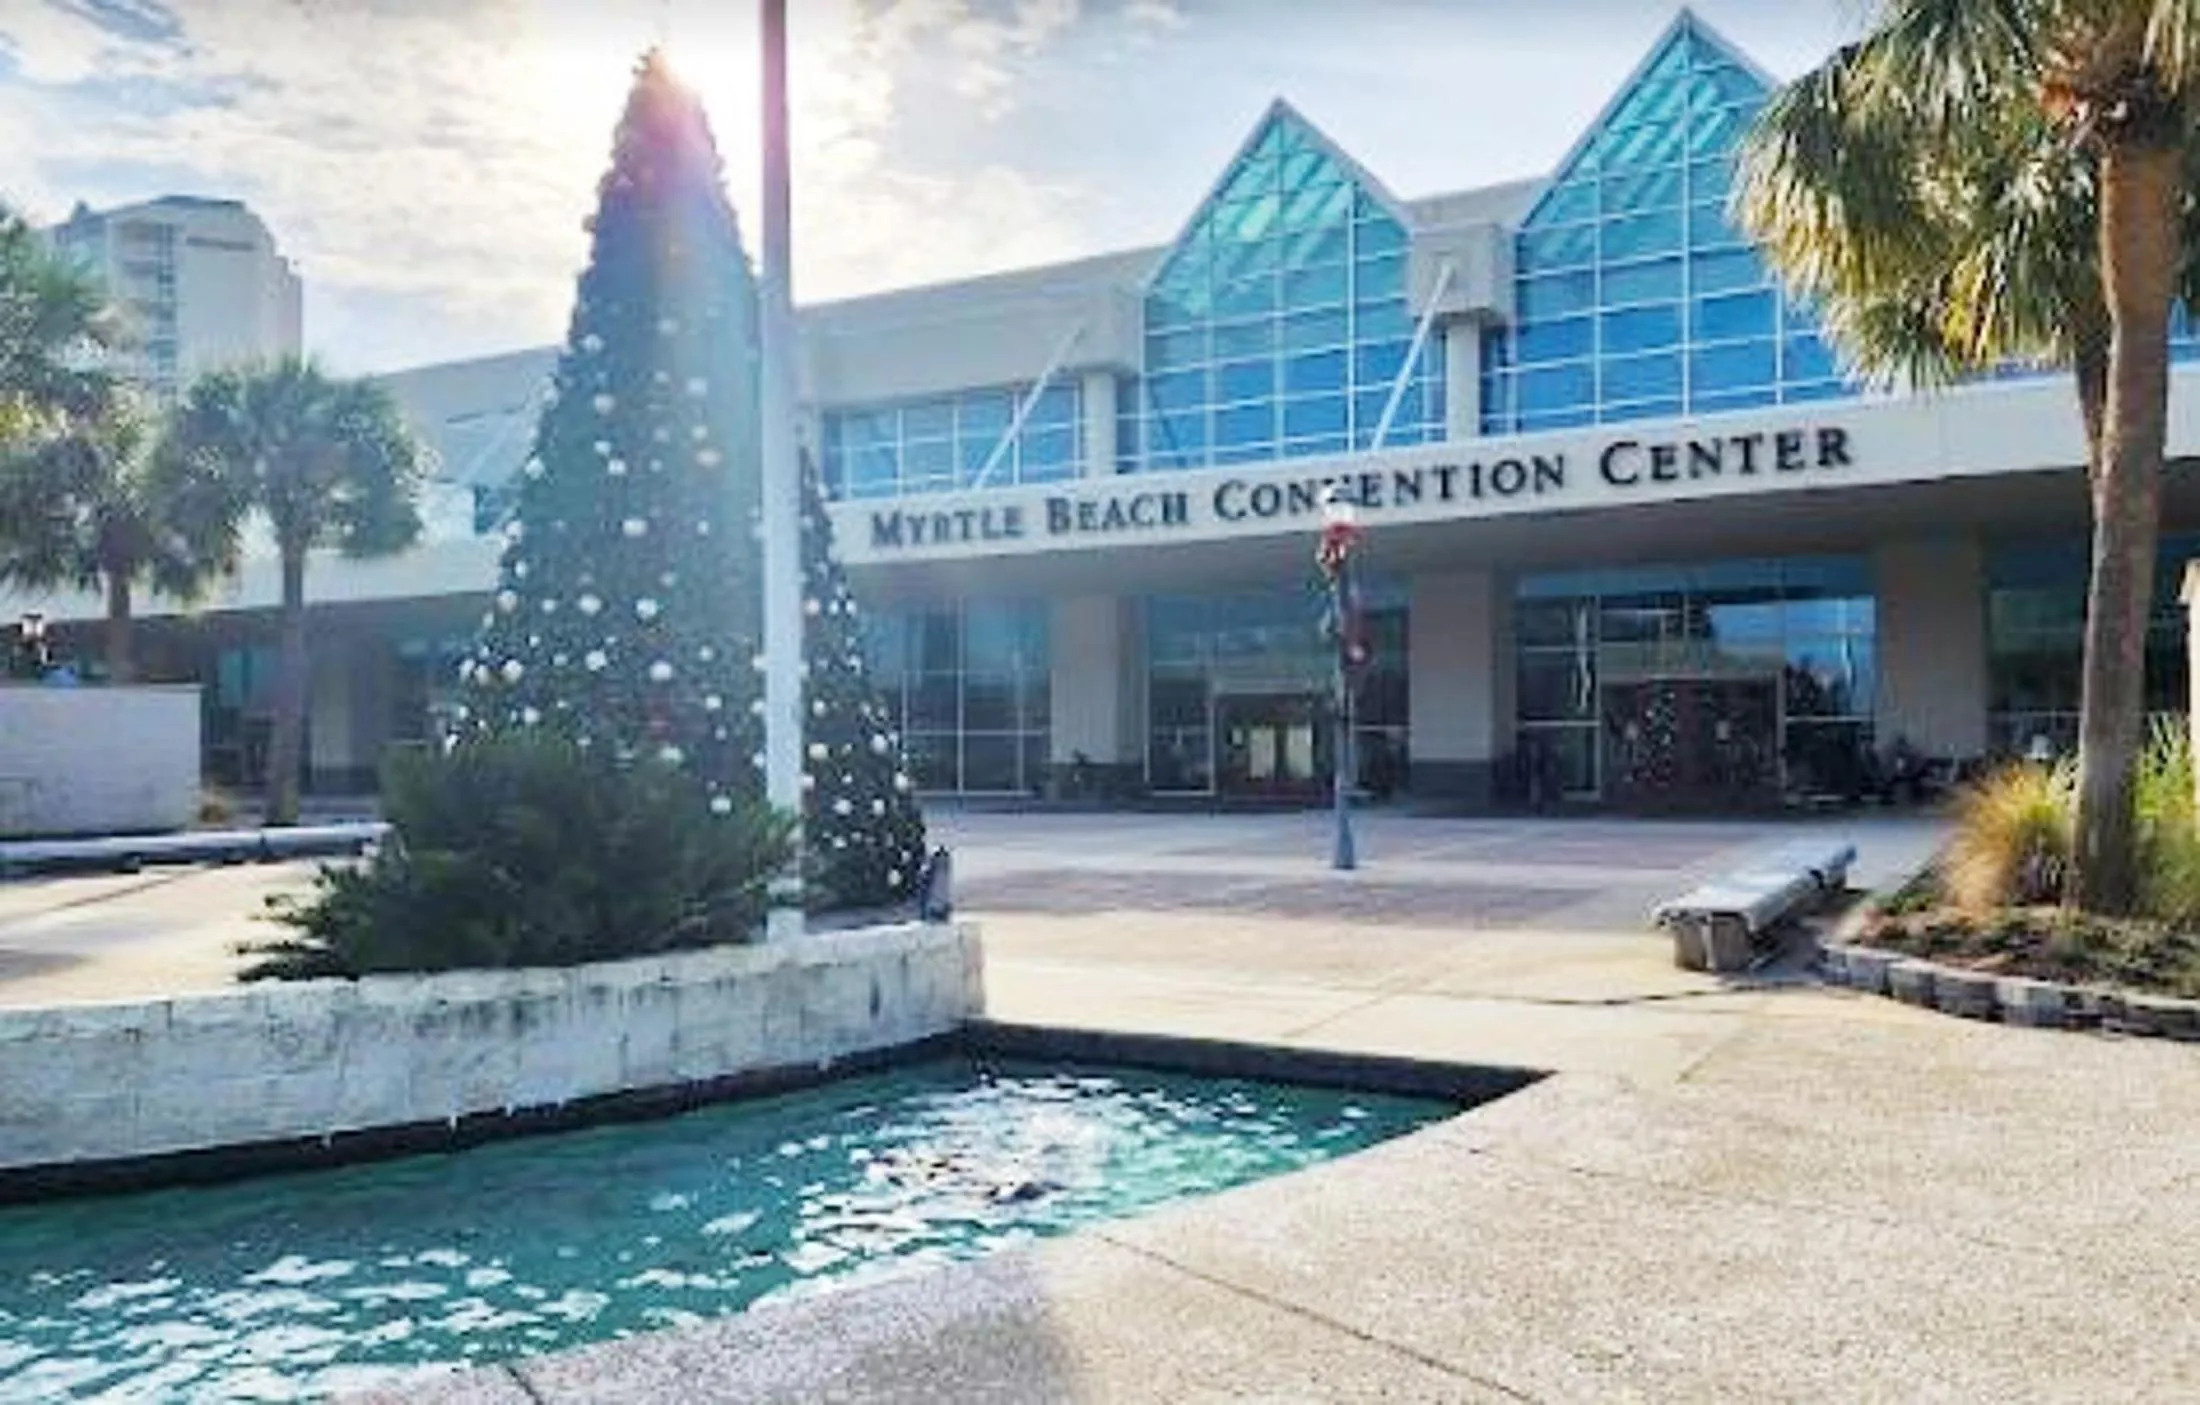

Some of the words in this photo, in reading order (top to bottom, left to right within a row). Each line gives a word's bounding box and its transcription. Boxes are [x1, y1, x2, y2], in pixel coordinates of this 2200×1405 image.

[870, 506, 1024, 547] MYRTLE
[1046, 491, 1190, 535] BEACH
[1600, 426, 1852, 486] CENTER
